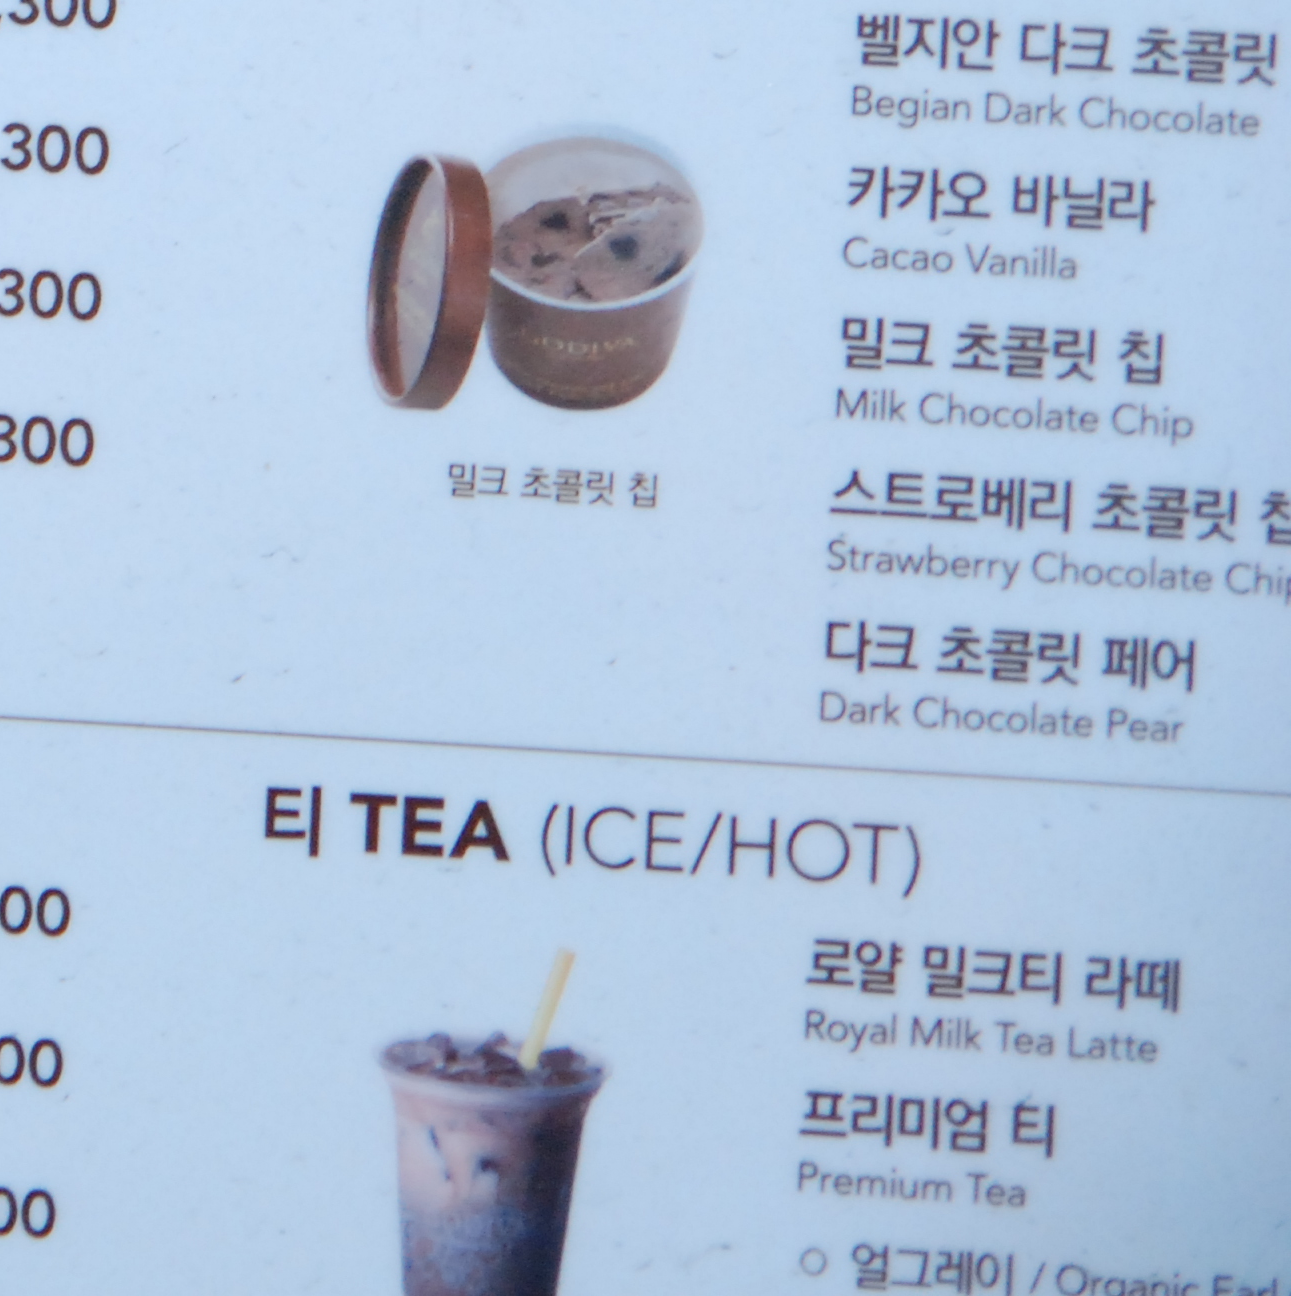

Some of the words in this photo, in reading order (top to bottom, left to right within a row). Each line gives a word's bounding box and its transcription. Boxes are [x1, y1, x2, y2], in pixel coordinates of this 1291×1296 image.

[857, 14, 1001, 72] 벨지안
[1020, 23, 1113, 77] 다크
[1132, 27, 1277, 87] 초콜릿
[851, 86, 973, 128] Begian
[984, 91, 1066, 127] Dark
[1079, 96, 1260, 138] Chocolate
[848, 166, 990, 222] 카카오
[1012, 173, 1156, 232] 바닐라
[842, 237, 955, 272] Cacao
[965, 243, 1078, 281] Vanilla
[842, 317, 934, 371] 밀크
[952, 321, 1098, 383] 초콜릿
[1119, 329, 1166, 385] 칩
[835, 389, 906, 424] Milk
[918, 395, 1101, 437] Chocolate
[1112, 405, 1194, 446] Chip
[446, 463, 507, 499] 밀크
[519, 467, 616, 505] 초콜릿
[628, 472, 659, 507] 칩
[830, 469, 1072, 531] 스트로베리
[1092, 483, 1237, 542] 초콜릿
[827, 541, 1020, 589] Strawberry
[1032, 550, 1213, 592] Chocolate
[826, 621, 918, 673] 다크
[936, 626, 1082, 687] 초콜릿
[1102, 637, 1197, 693] 페어
[819, 693, 902, 729] Dark
[913, 697, 1094, 741] Chocolate
[1106, 709, 1182, 745] Pear
[264, 787, 322, 857] 티
[350, 793, 510, 864] TEA
[540, 803, 923, 897] (ICE/HOT)
[806, 937, 900, 998] 로얄
[923, 943, 1061, 1005] 밀크티
[1085, 954, 1182, 1013] 라떼
[804, 1011, 898, 1052] Royal
[910, 1017, 984, 1052] Milk
[997, 1024, 1056, 1059] Tea
[1066, 1028, 1159, 1063] Latte
[800, 1088, 988, 1151] 프리미엄
[1012, 1100, 1056, 1157] 티
[797, 1162, 953, 1204] Premium
[965, 1171, 1026, 1210] Tea
[852, 1242, 1014, 1295] 얼그레이
